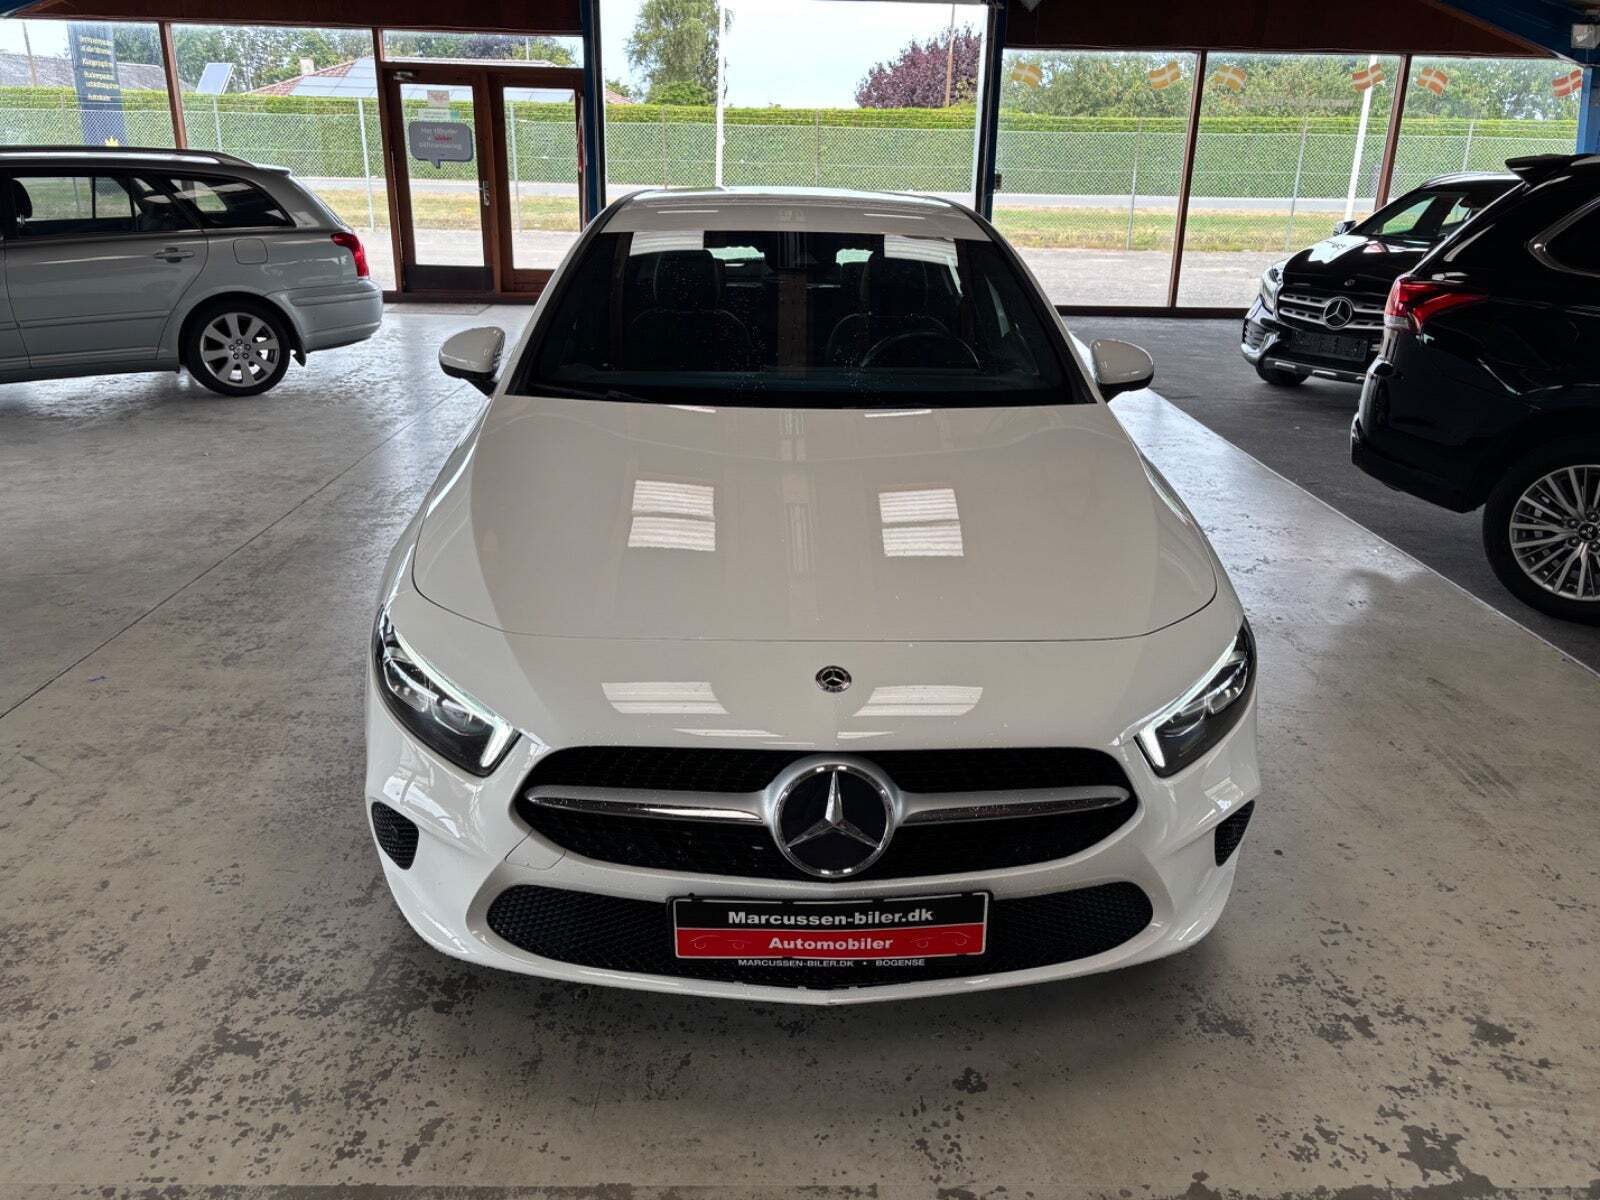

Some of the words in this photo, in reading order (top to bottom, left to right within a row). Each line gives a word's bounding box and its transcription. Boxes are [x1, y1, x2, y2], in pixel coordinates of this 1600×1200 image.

[728, 909, 934, 926] Marcussen-biler.dk
[768, 937, 894, 950] Automobiler
[738, 959, 855, 968] MARCUSSEN-BILER.DK
[875, 959, 926, 967] BOGENSE
